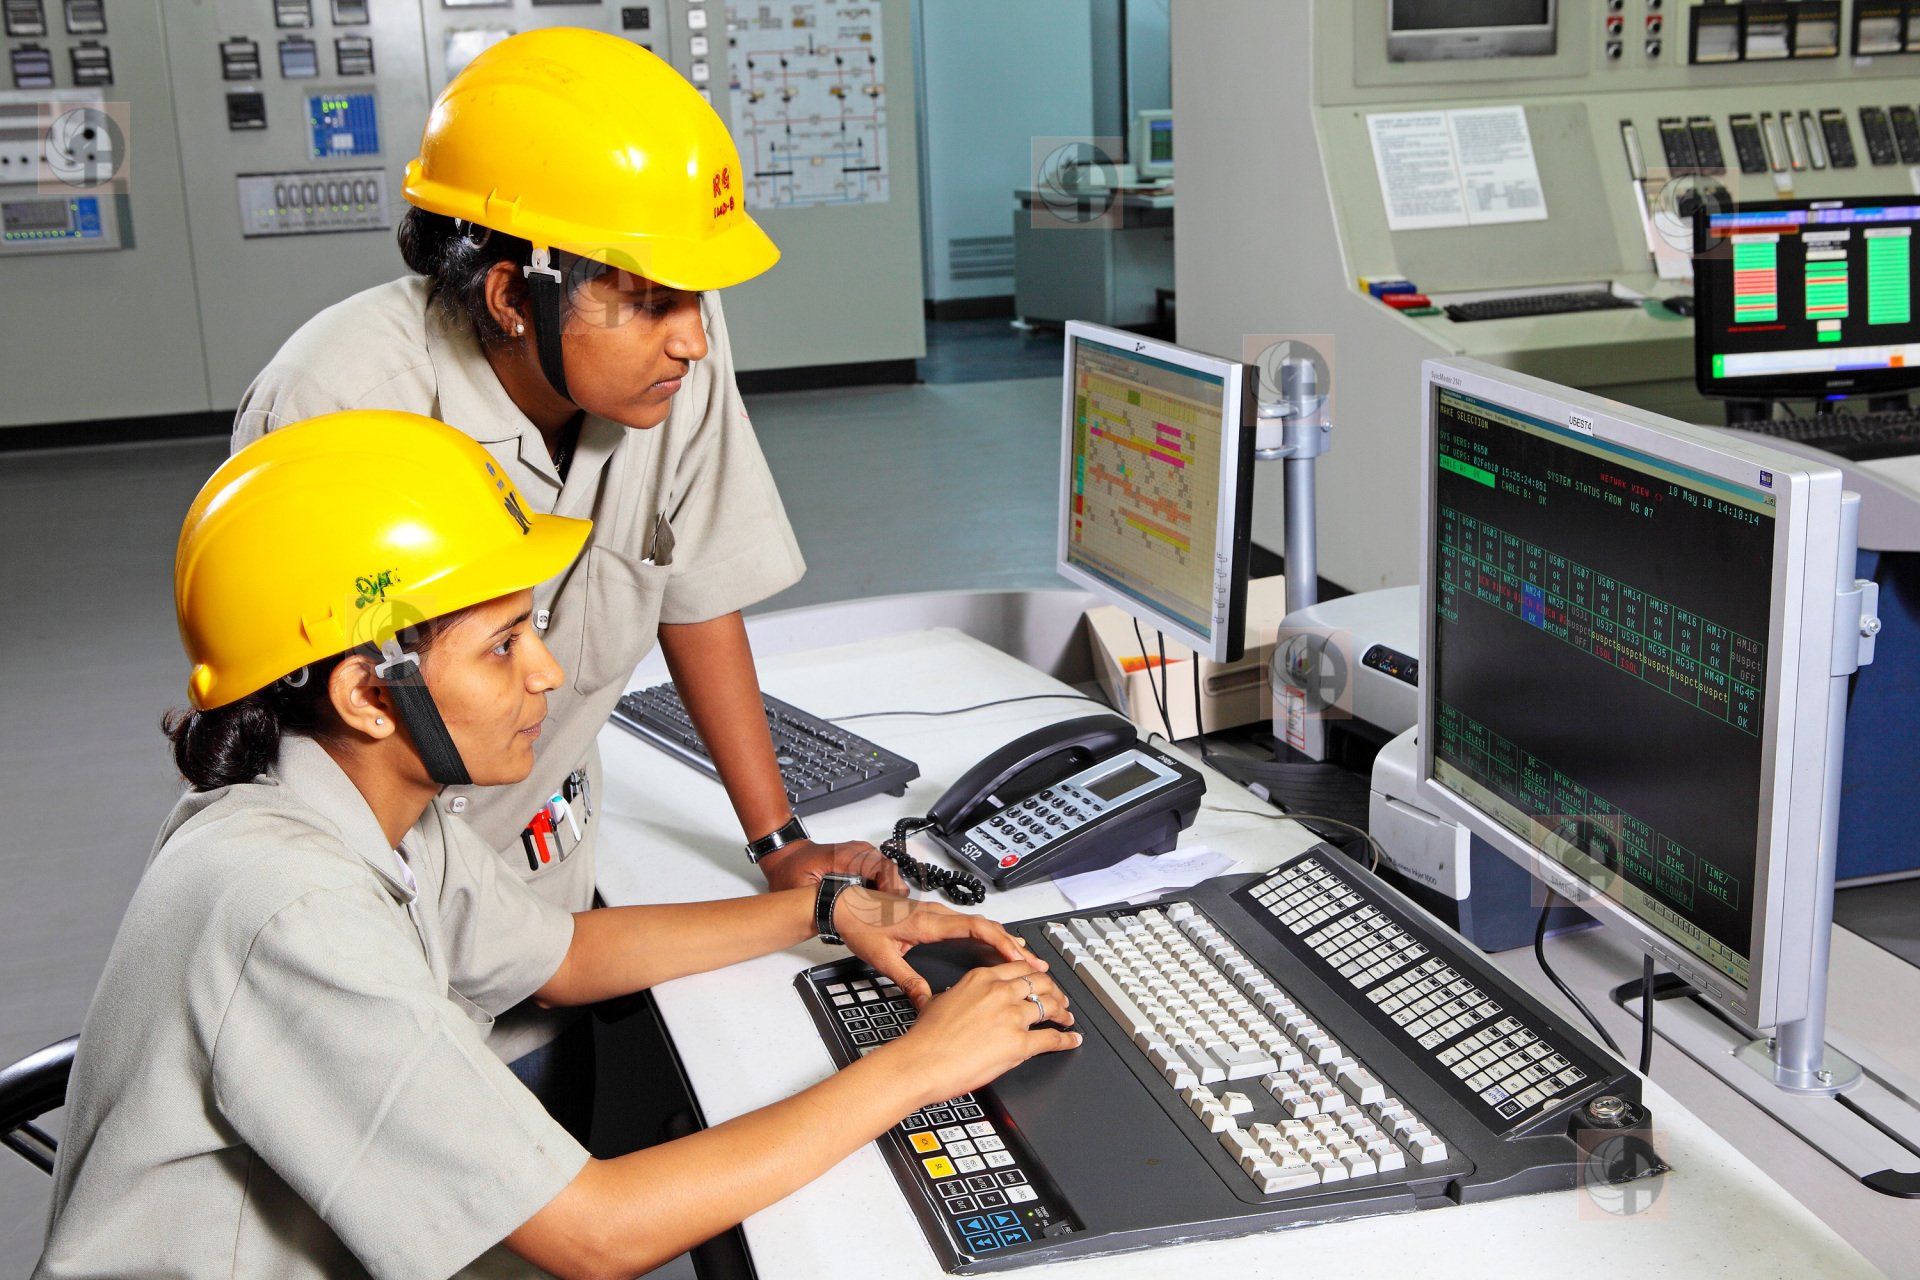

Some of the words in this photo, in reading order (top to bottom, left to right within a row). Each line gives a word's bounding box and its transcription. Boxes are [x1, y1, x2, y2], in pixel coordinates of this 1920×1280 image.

[1457, 411, 1489, 430] SELECTION
[1547, 470, 1571, 487] SYSTEM
[1575, 481, 1600, 498] STATUS
[1604, 492, 1622, 506] FROM
[1630, 501, 1640, 513] US
[1668, 486, 1678, 497] 18
[1683, 490, 1698, 506] May
[1703, 498, 1712, 508] 10
[1572, 565, 1589, 579] US07
[1598, 576, 1615, 591] US08
[1596, 618, 1613, 633] US32
[1626, 618, 1635, 629] OK
[1678, 611, 1697, 627] AM16
[1543, 620, 1567, 638] BACKUP
[1653, 630, 1662, 641] OK
[1707, 624, 1726, 640] AM17
[1591, 631, 1616, 648] suspct
[1617, 642, 1642, 661] suspct
[1681, 643, 1690, 655] OK
[1643, 657, 1669, 675] suspct
[1676, 655, 1695, 672] HG36
[1710, 656, 1720, 668] OK
[1671, 669, 1698, 689] suspct
[1699, 684, 1728, 703] suspct
[1735, 683, 1755, 700] HG45
[1739, 702, 1748, 713] ok
[1738, 716, 1747, 728] OK
[1524, 768, 1546, 787] SELECT
[1623, 815, 1649, 837] STATUS
[1623, 828, 1648, 851] DETAIL
[961, 842, 982, 860] 5512
[1666, 855, 1685, 873] DIAG
[1705, 864, 1729, 884] TIME/
[1708, 881, 1728, 901] DATE
[956, 1200, 966, 1209] OUT
